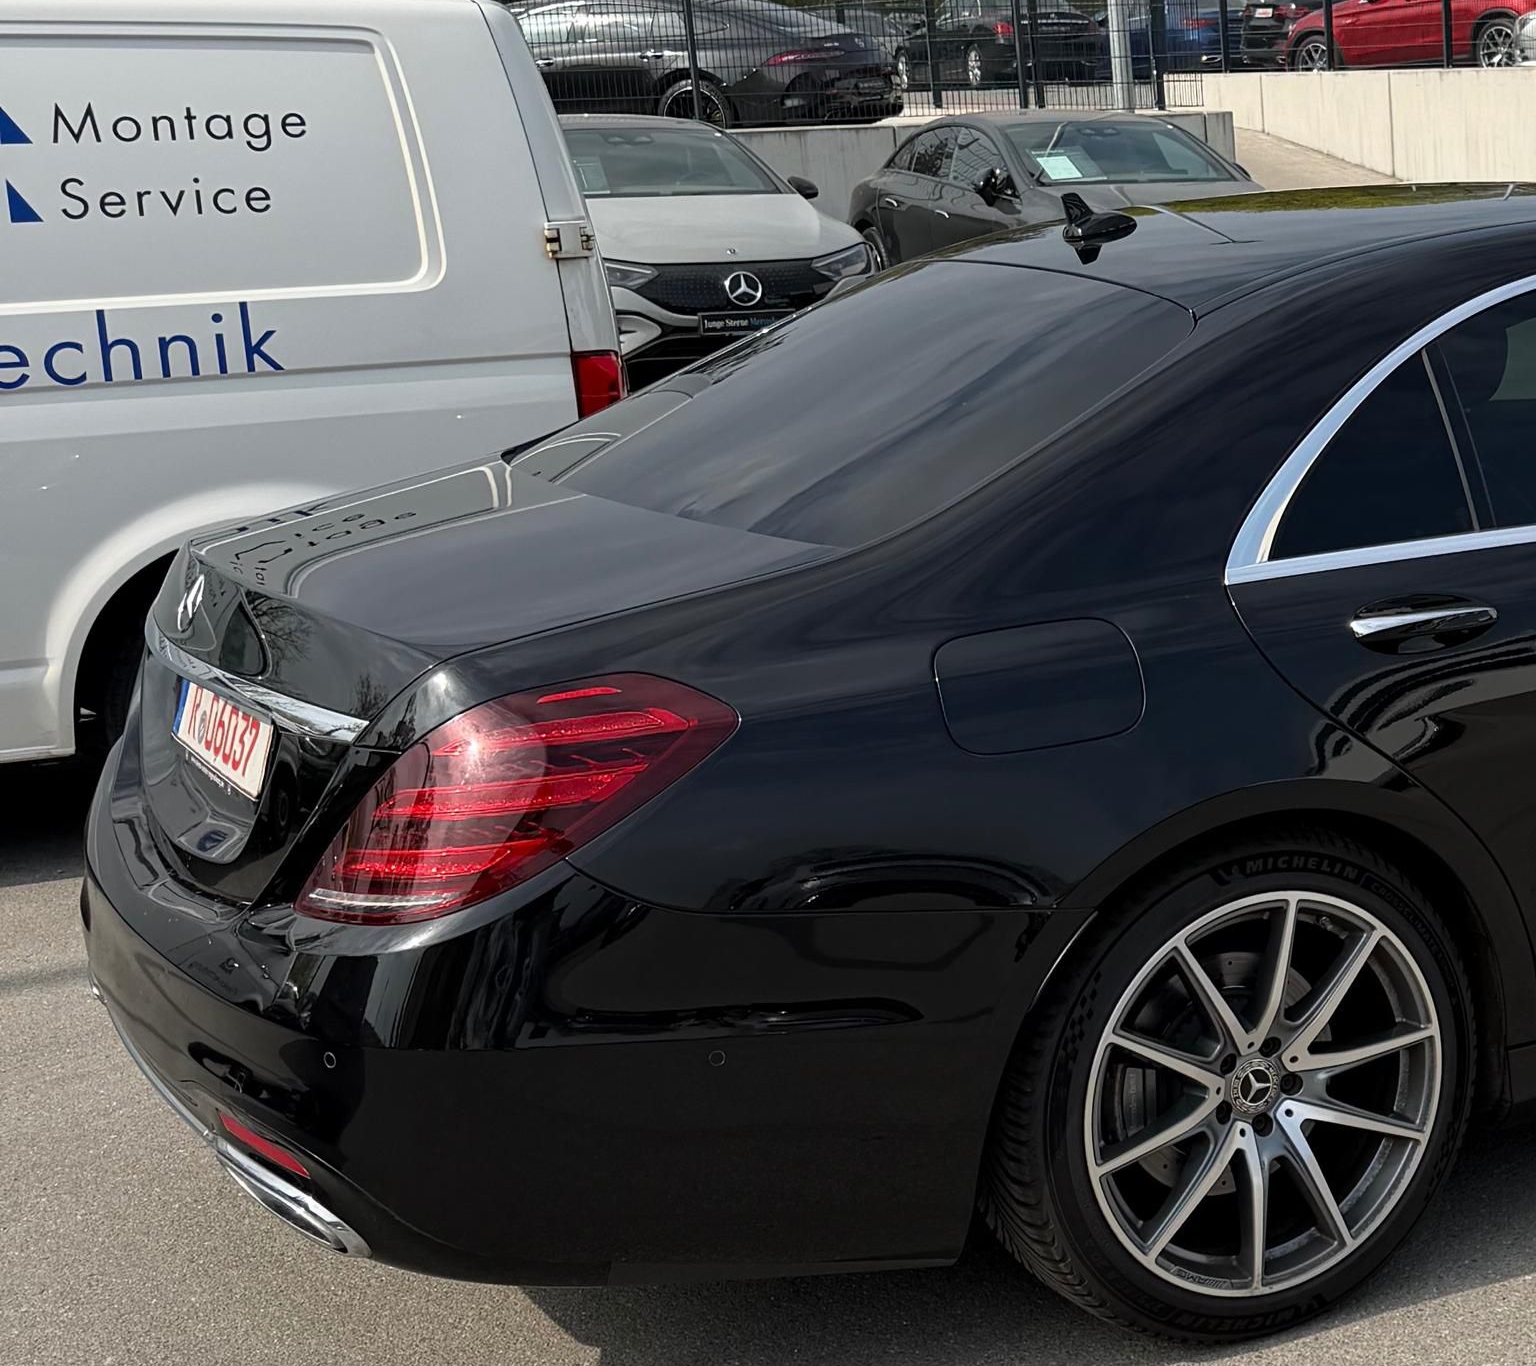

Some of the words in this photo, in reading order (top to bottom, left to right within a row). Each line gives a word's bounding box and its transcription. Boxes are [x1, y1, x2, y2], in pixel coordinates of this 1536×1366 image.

[53, 102, 307, 152] Montage
[60, 177, 271, 220] Service
[0, 301, 285, 389] echnik
[204, 695, 260, 777] 06037
[1245, 855, 1359, 881] MICHELIN
